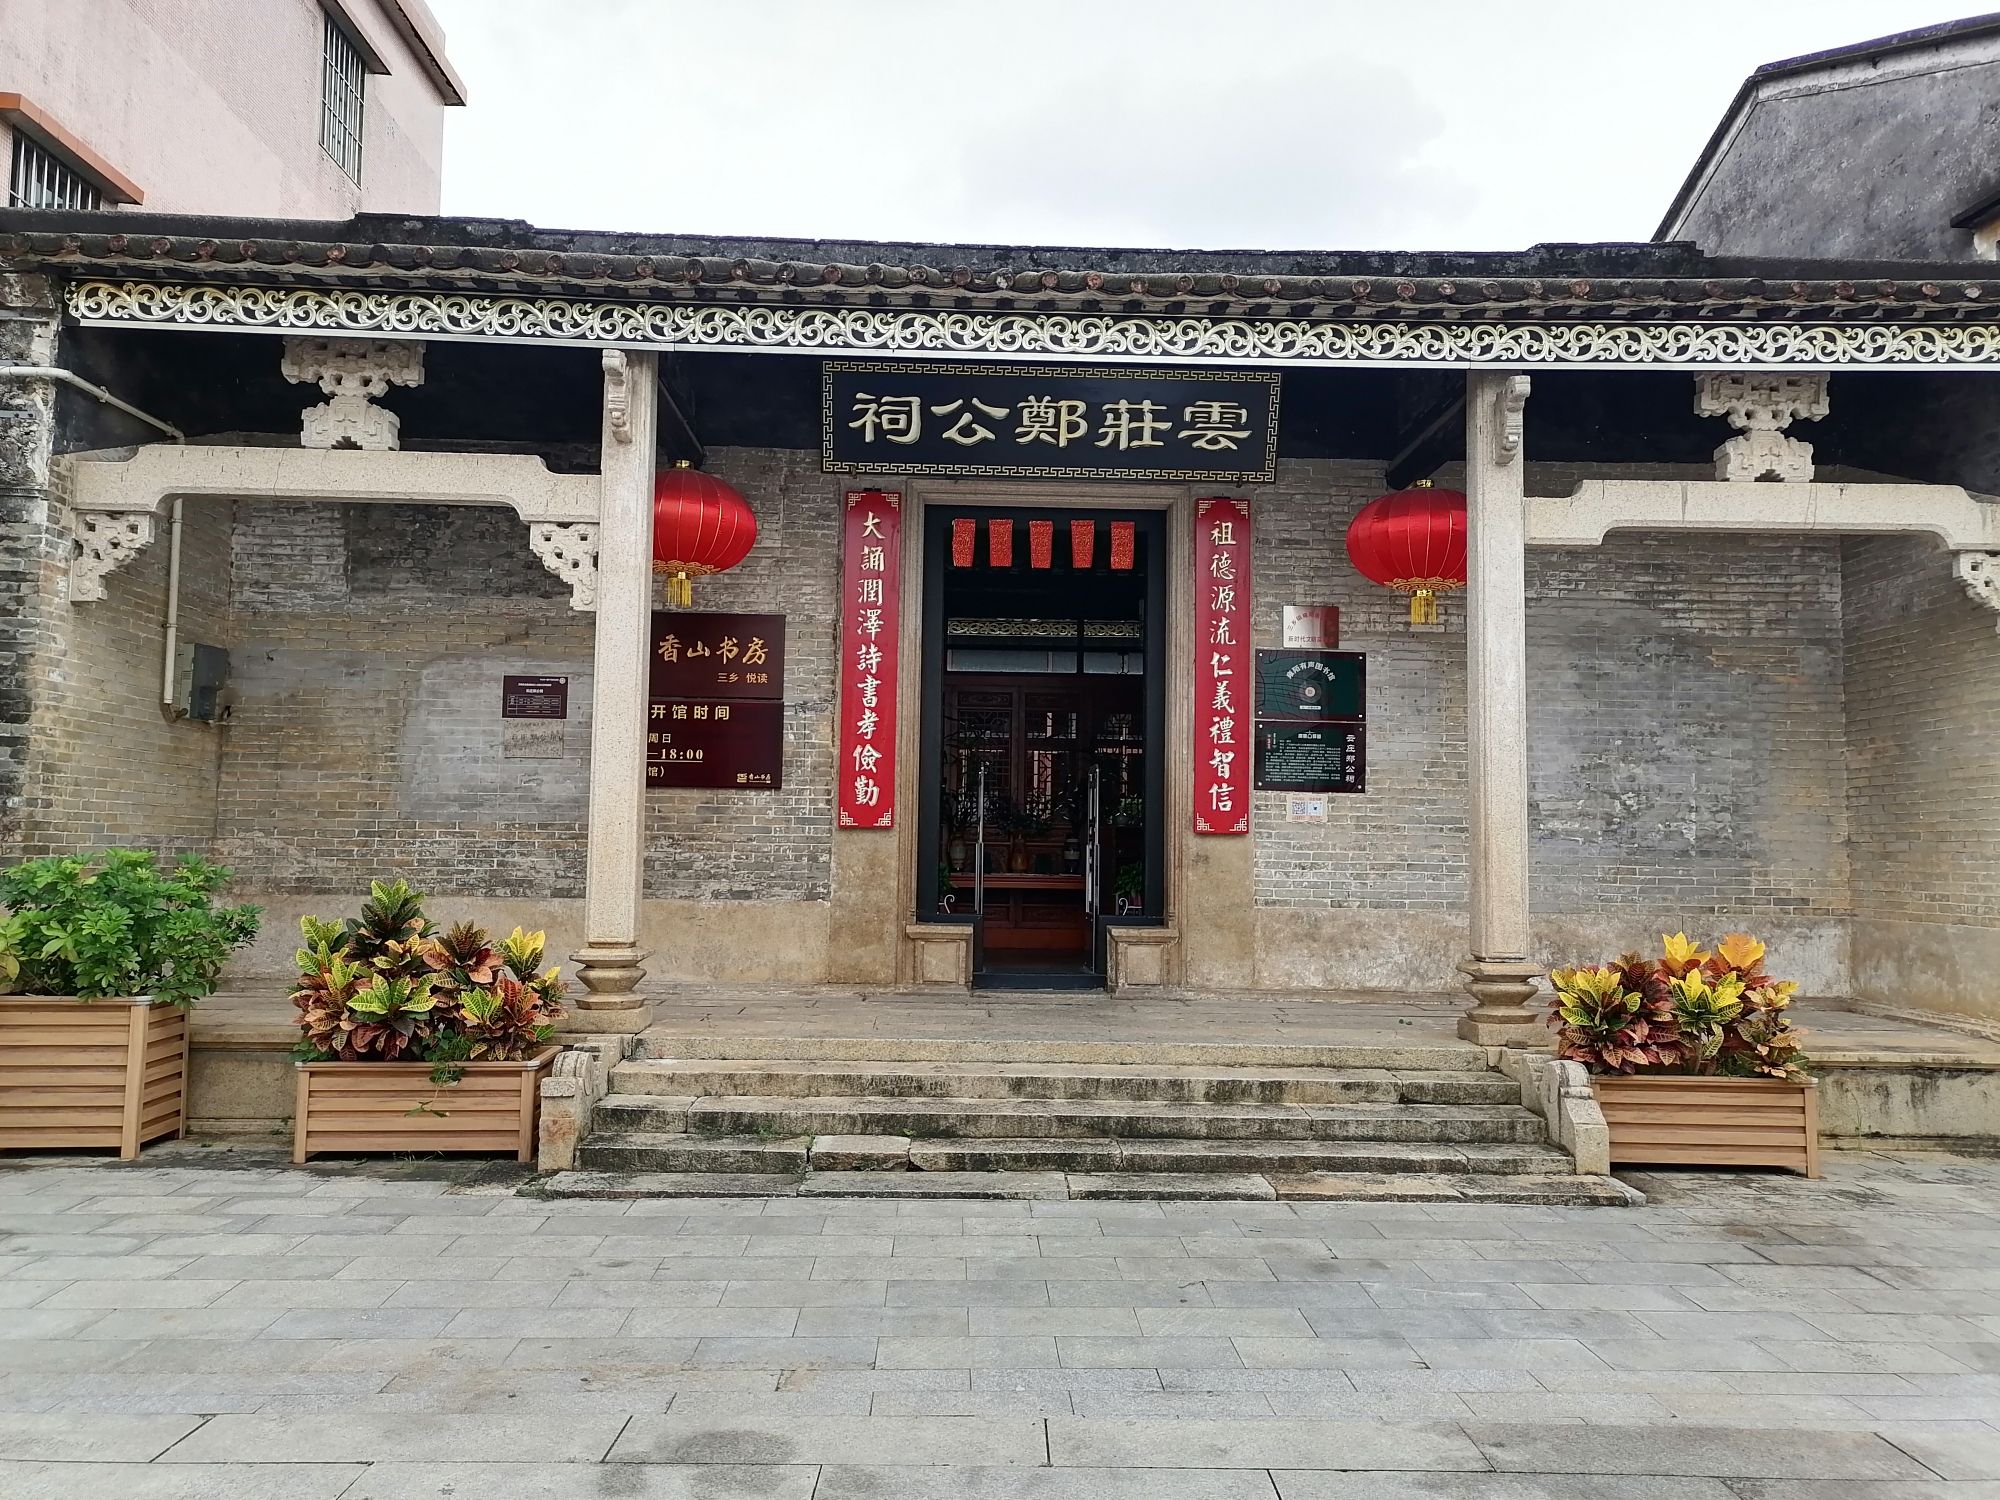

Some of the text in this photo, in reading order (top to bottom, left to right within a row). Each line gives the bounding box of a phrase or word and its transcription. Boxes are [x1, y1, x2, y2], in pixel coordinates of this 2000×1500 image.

[658, 633, 768, 665] 香山书房
[1208, 520, 1237, 812] 祖德源流仁義禮智信
[717, 672, 768, 684] 三乡 悦读
[651, 705, 730, 720] 开馆时间
[648, 733, 671, 743] 周日
